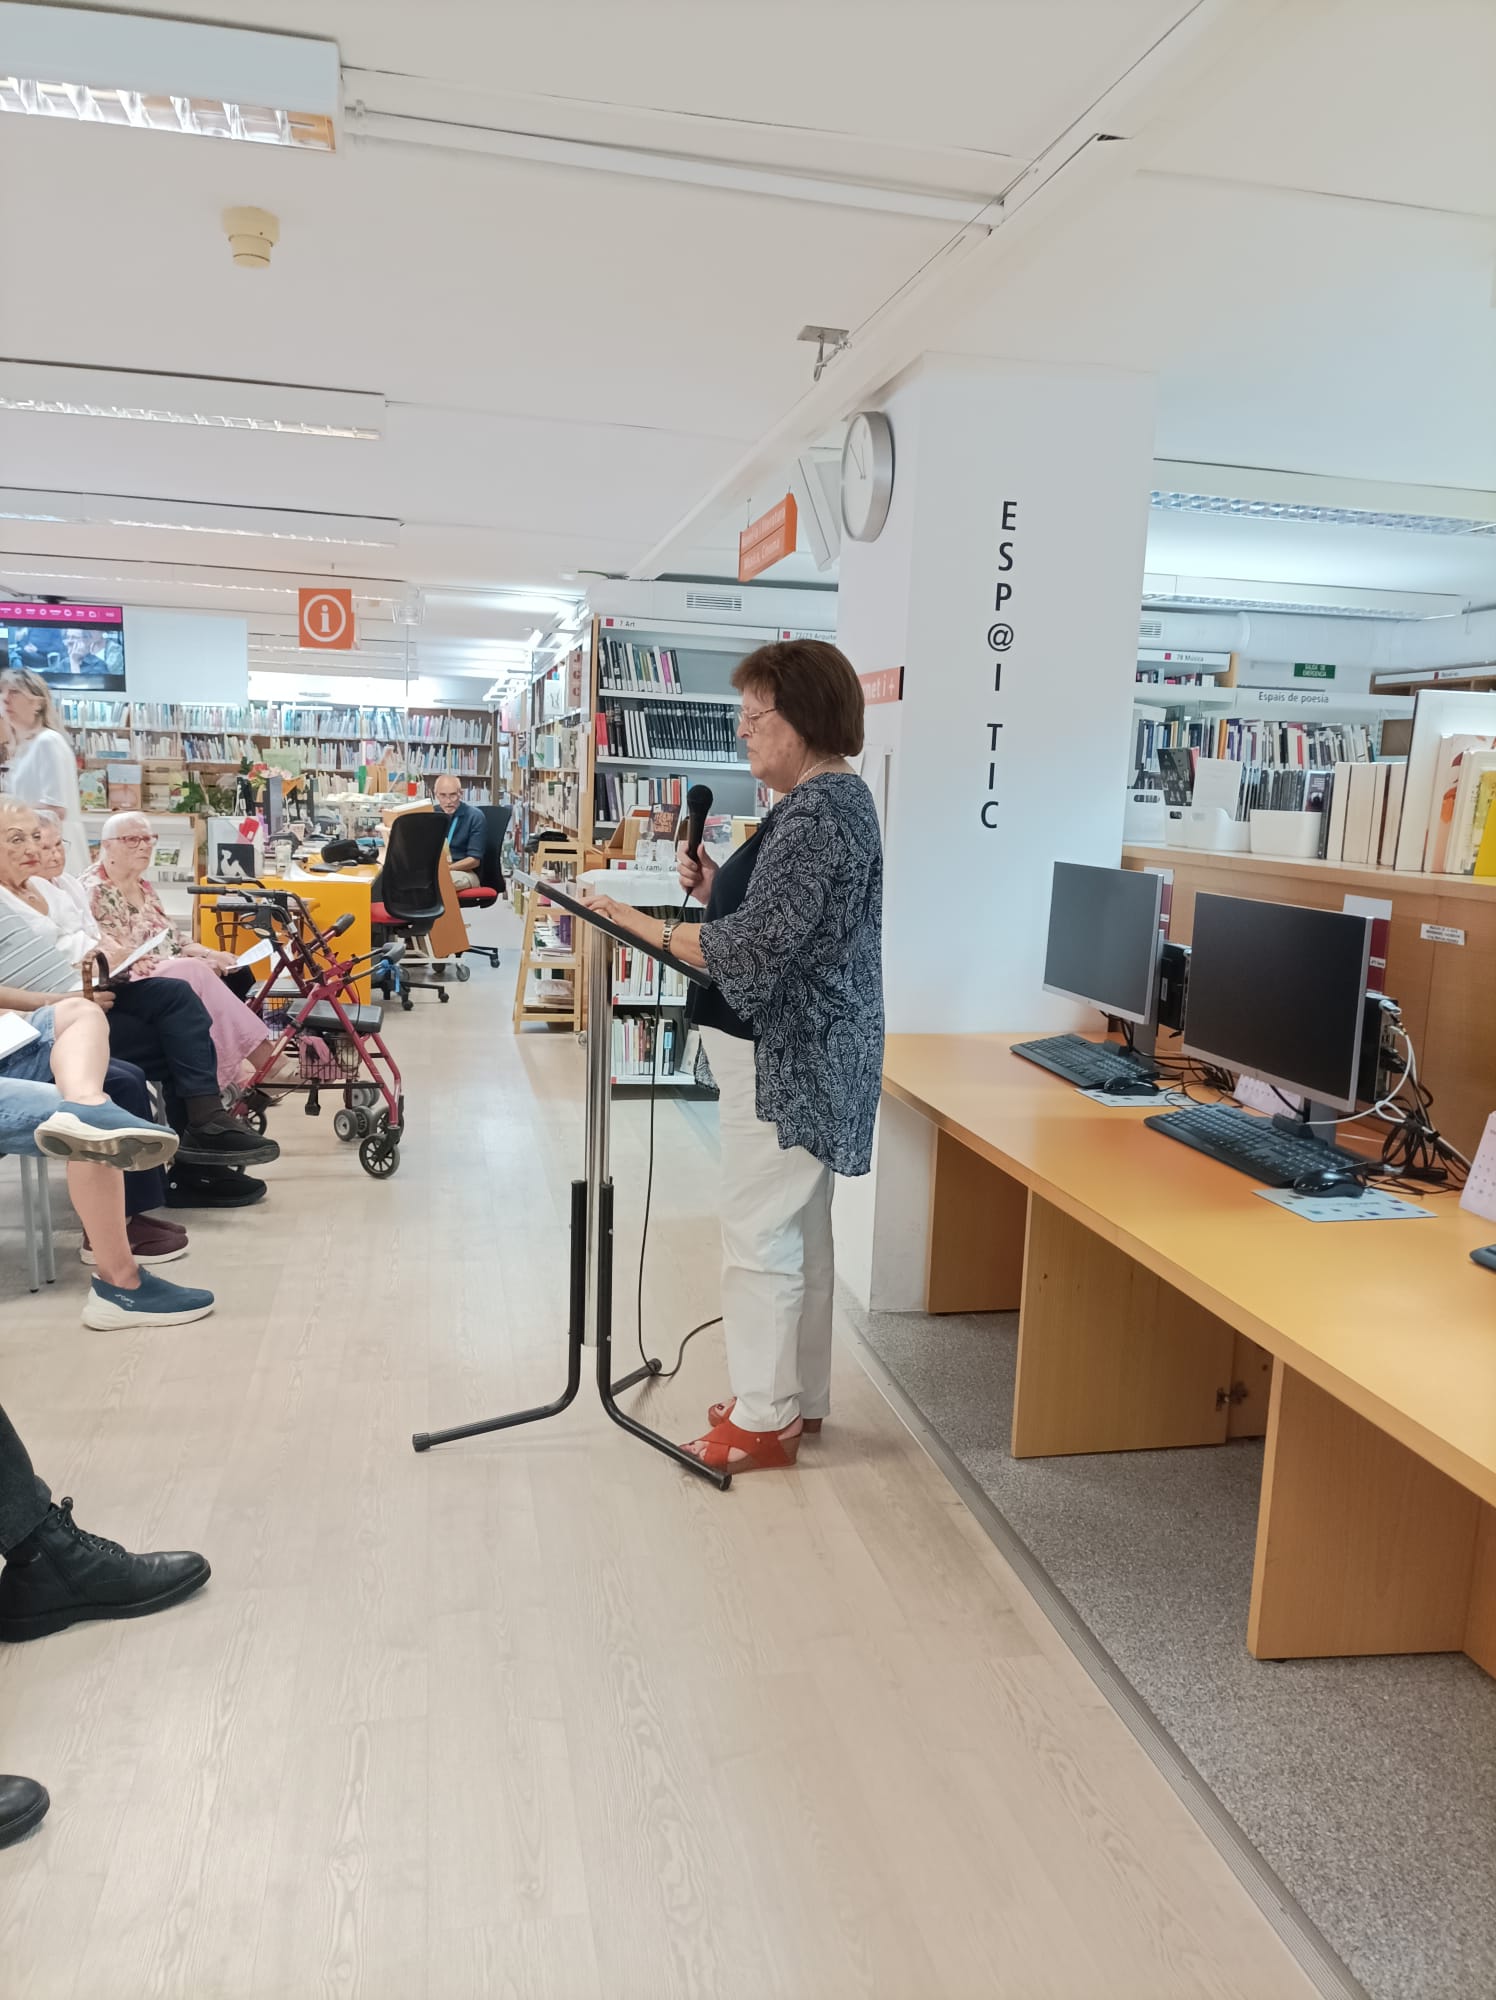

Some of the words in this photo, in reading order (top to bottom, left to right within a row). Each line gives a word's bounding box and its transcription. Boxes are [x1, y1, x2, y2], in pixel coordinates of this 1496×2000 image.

[1258, 690, 1285, 703] Espais
[1287, 692, 1299, 702] de
[1300, 694, 1329, 705] poesia
[980, 723, 1003, 829] TIC
